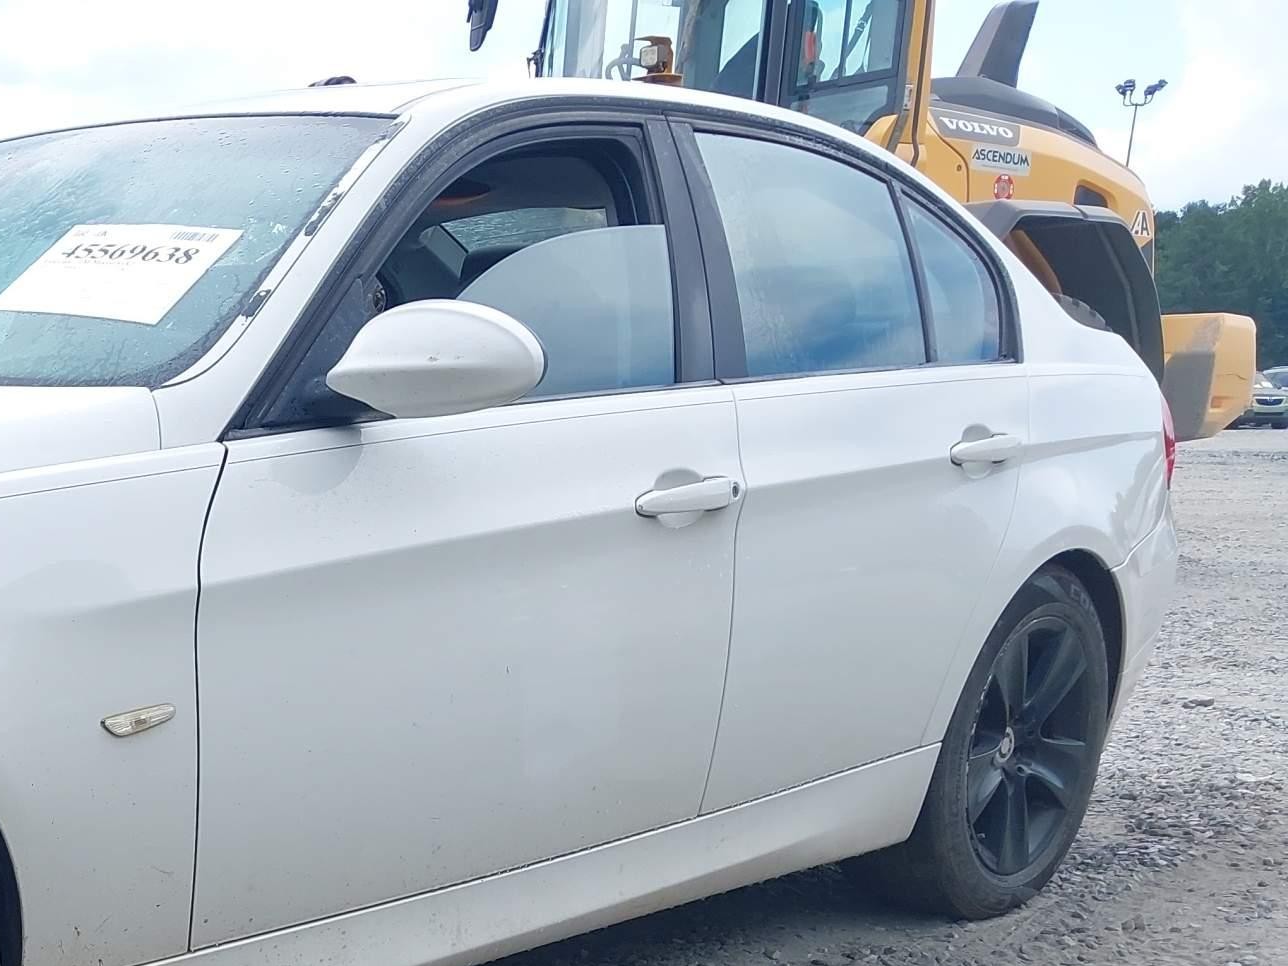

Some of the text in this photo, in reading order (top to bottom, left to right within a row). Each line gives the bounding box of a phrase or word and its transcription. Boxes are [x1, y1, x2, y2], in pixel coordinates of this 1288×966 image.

[939, 116, 1014, 138] VOLVO
[972, 148, 1030, 167] ASCENDUM
[61, 243, 200, 265] 45569638
